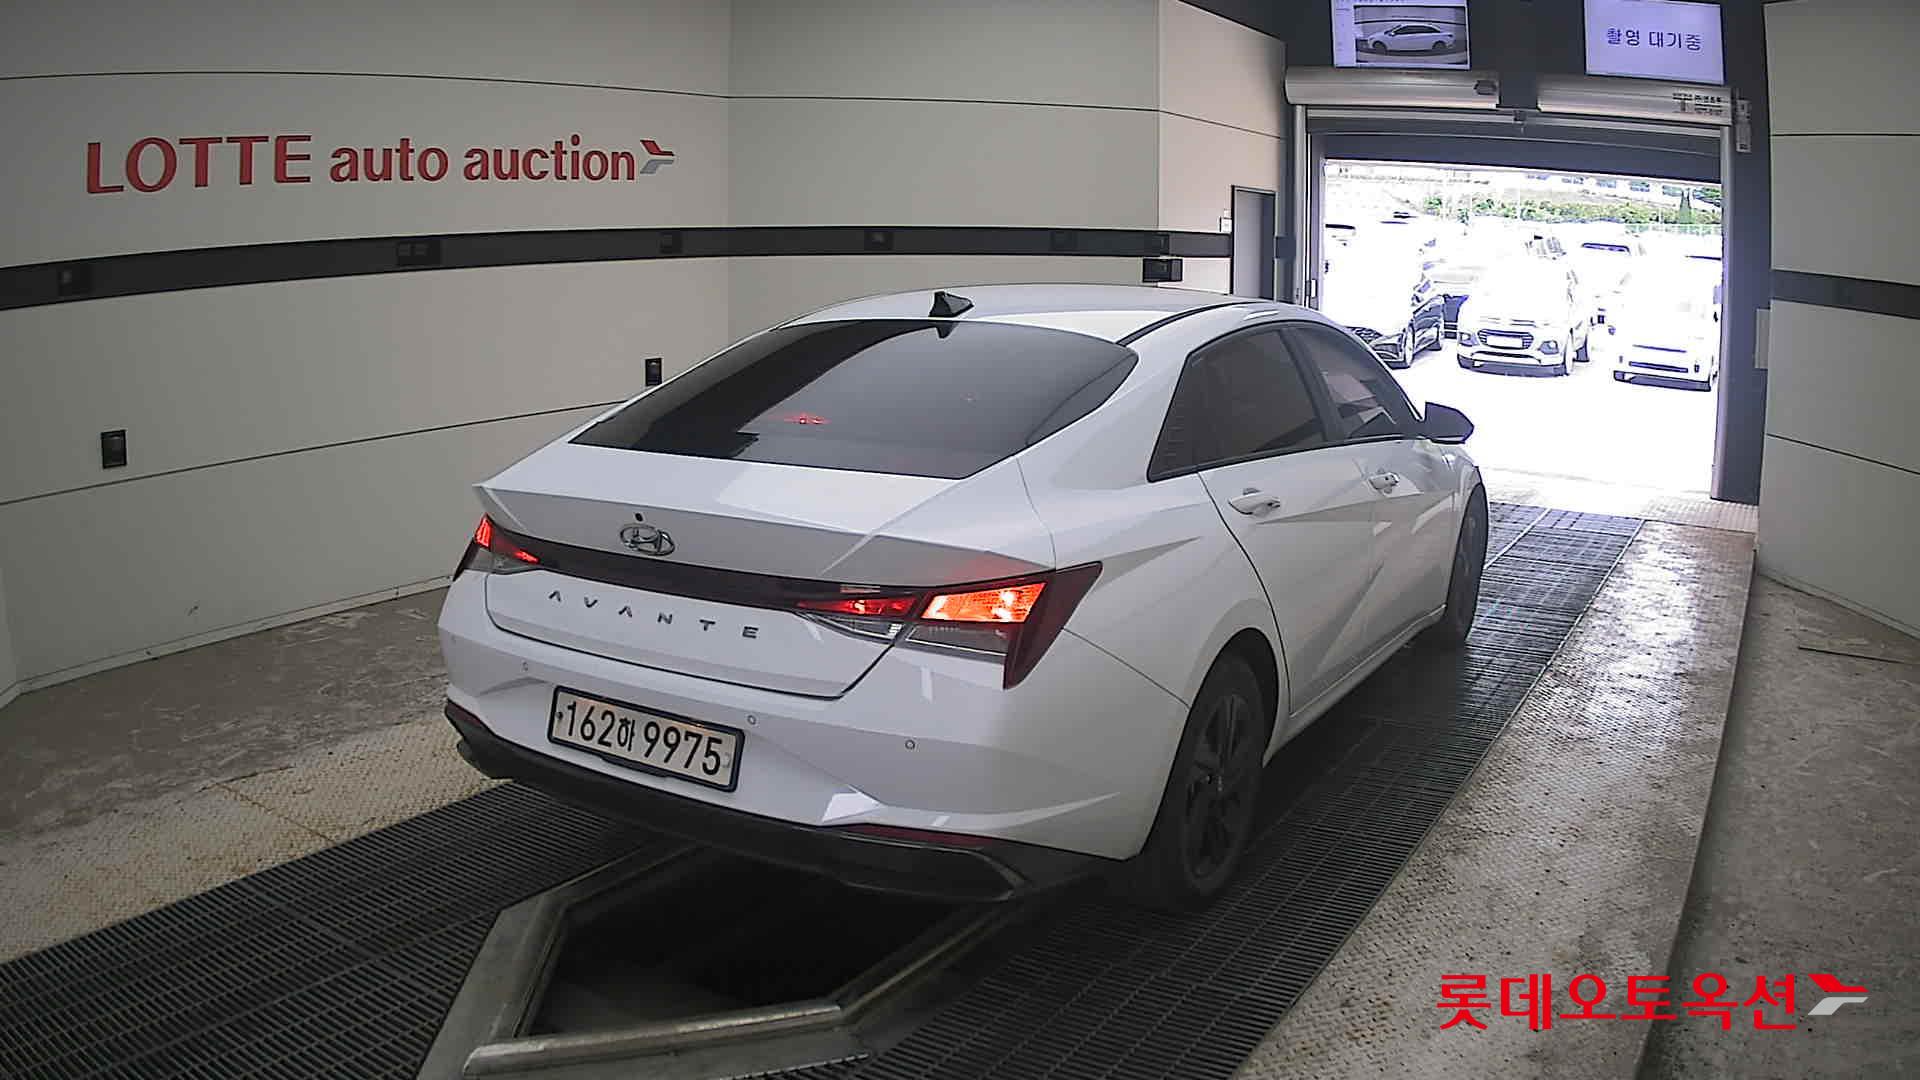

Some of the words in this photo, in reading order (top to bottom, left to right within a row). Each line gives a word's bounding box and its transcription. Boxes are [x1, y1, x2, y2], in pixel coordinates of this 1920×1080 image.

[1606, 28, 1641, 48] 촬영
[1648, 31, 1704, 52] 대기중
[86, 135, 313, 194] LOTTE
[329, 138, 449, 183] auto
[464, 134, 636, 182] auction
[548, 590, 760, 640] AVANTE
[567, 701, 636, 752] 162하
[643, 721, 723, 776] 9975
